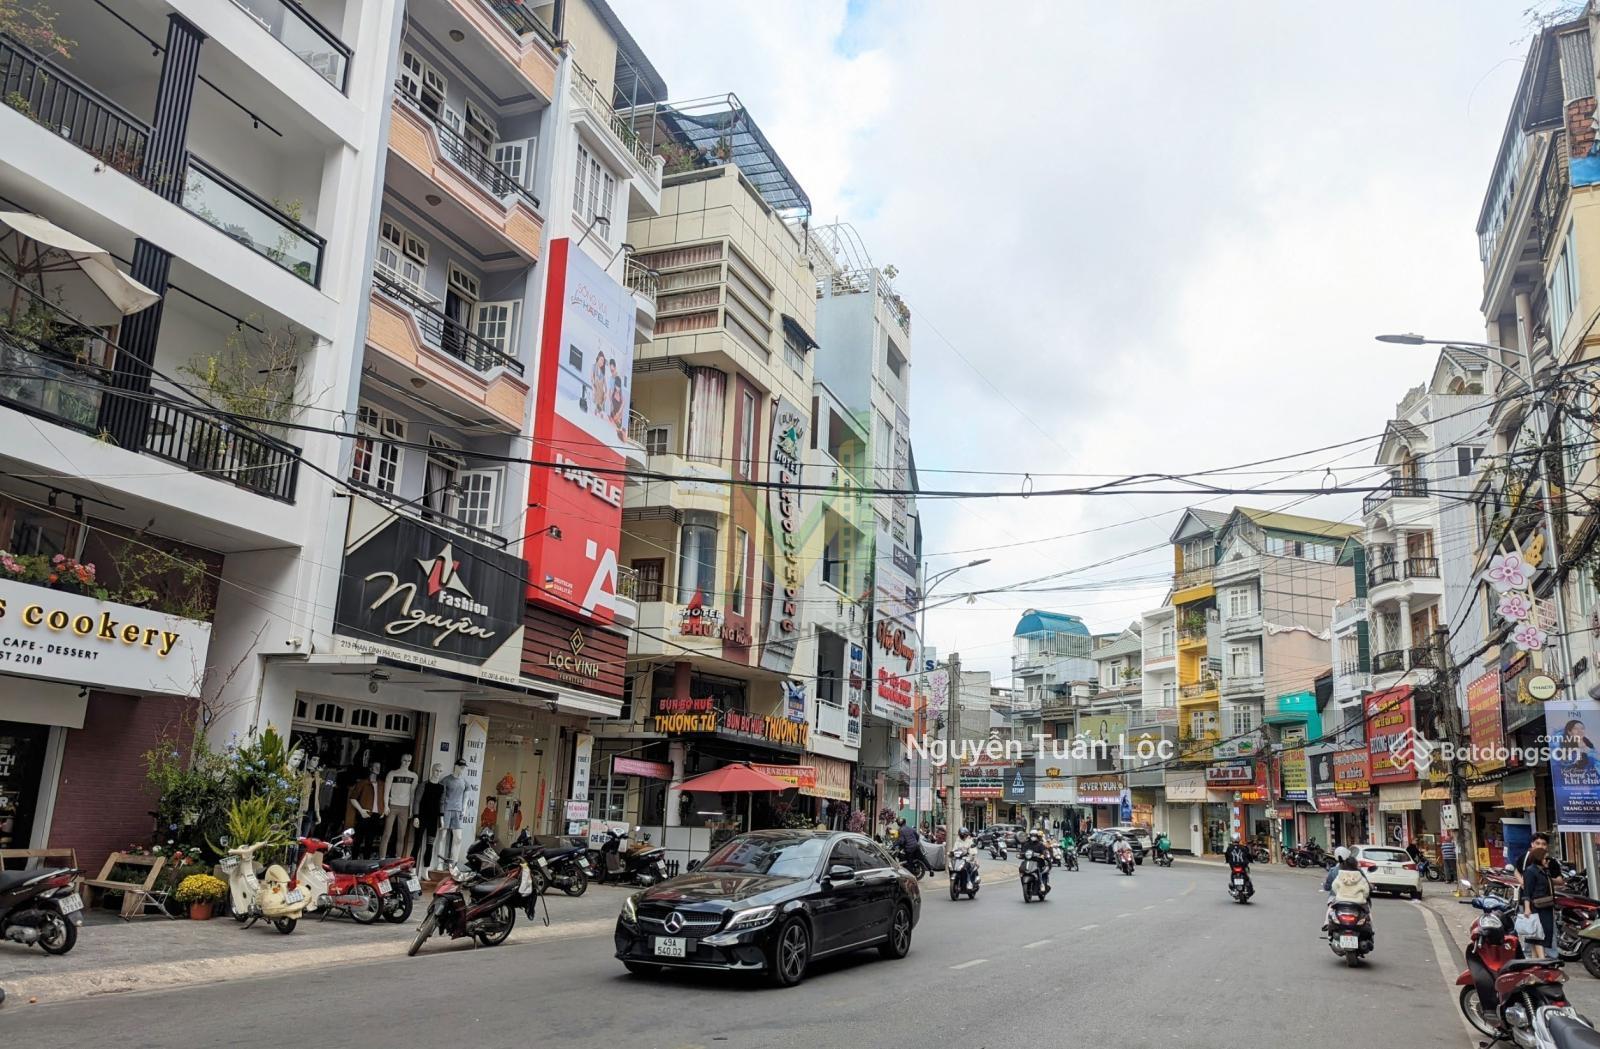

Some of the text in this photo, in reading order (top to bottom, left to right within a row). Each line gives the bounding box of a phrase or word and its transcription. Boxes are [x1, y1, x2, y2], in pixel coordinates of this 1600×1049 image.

[364, 571, 496, 647] Nguyên
[438, 591, 489, 617] Fashion
[681, 607, 723, 619] HOTEL
[25, 605, 180, 656] cookery
[3, 637, 36, 651] CAFE
[47, 644, 100, 661] DESSERT
[340, 640, 351, 649] 213
[15, 654, 43, 665] 2018
[548, 651, 599, 678] LỘC VINH
[654, 713, 698, 736] THƯỢNG
[663, 938, 677, 947] 49A
